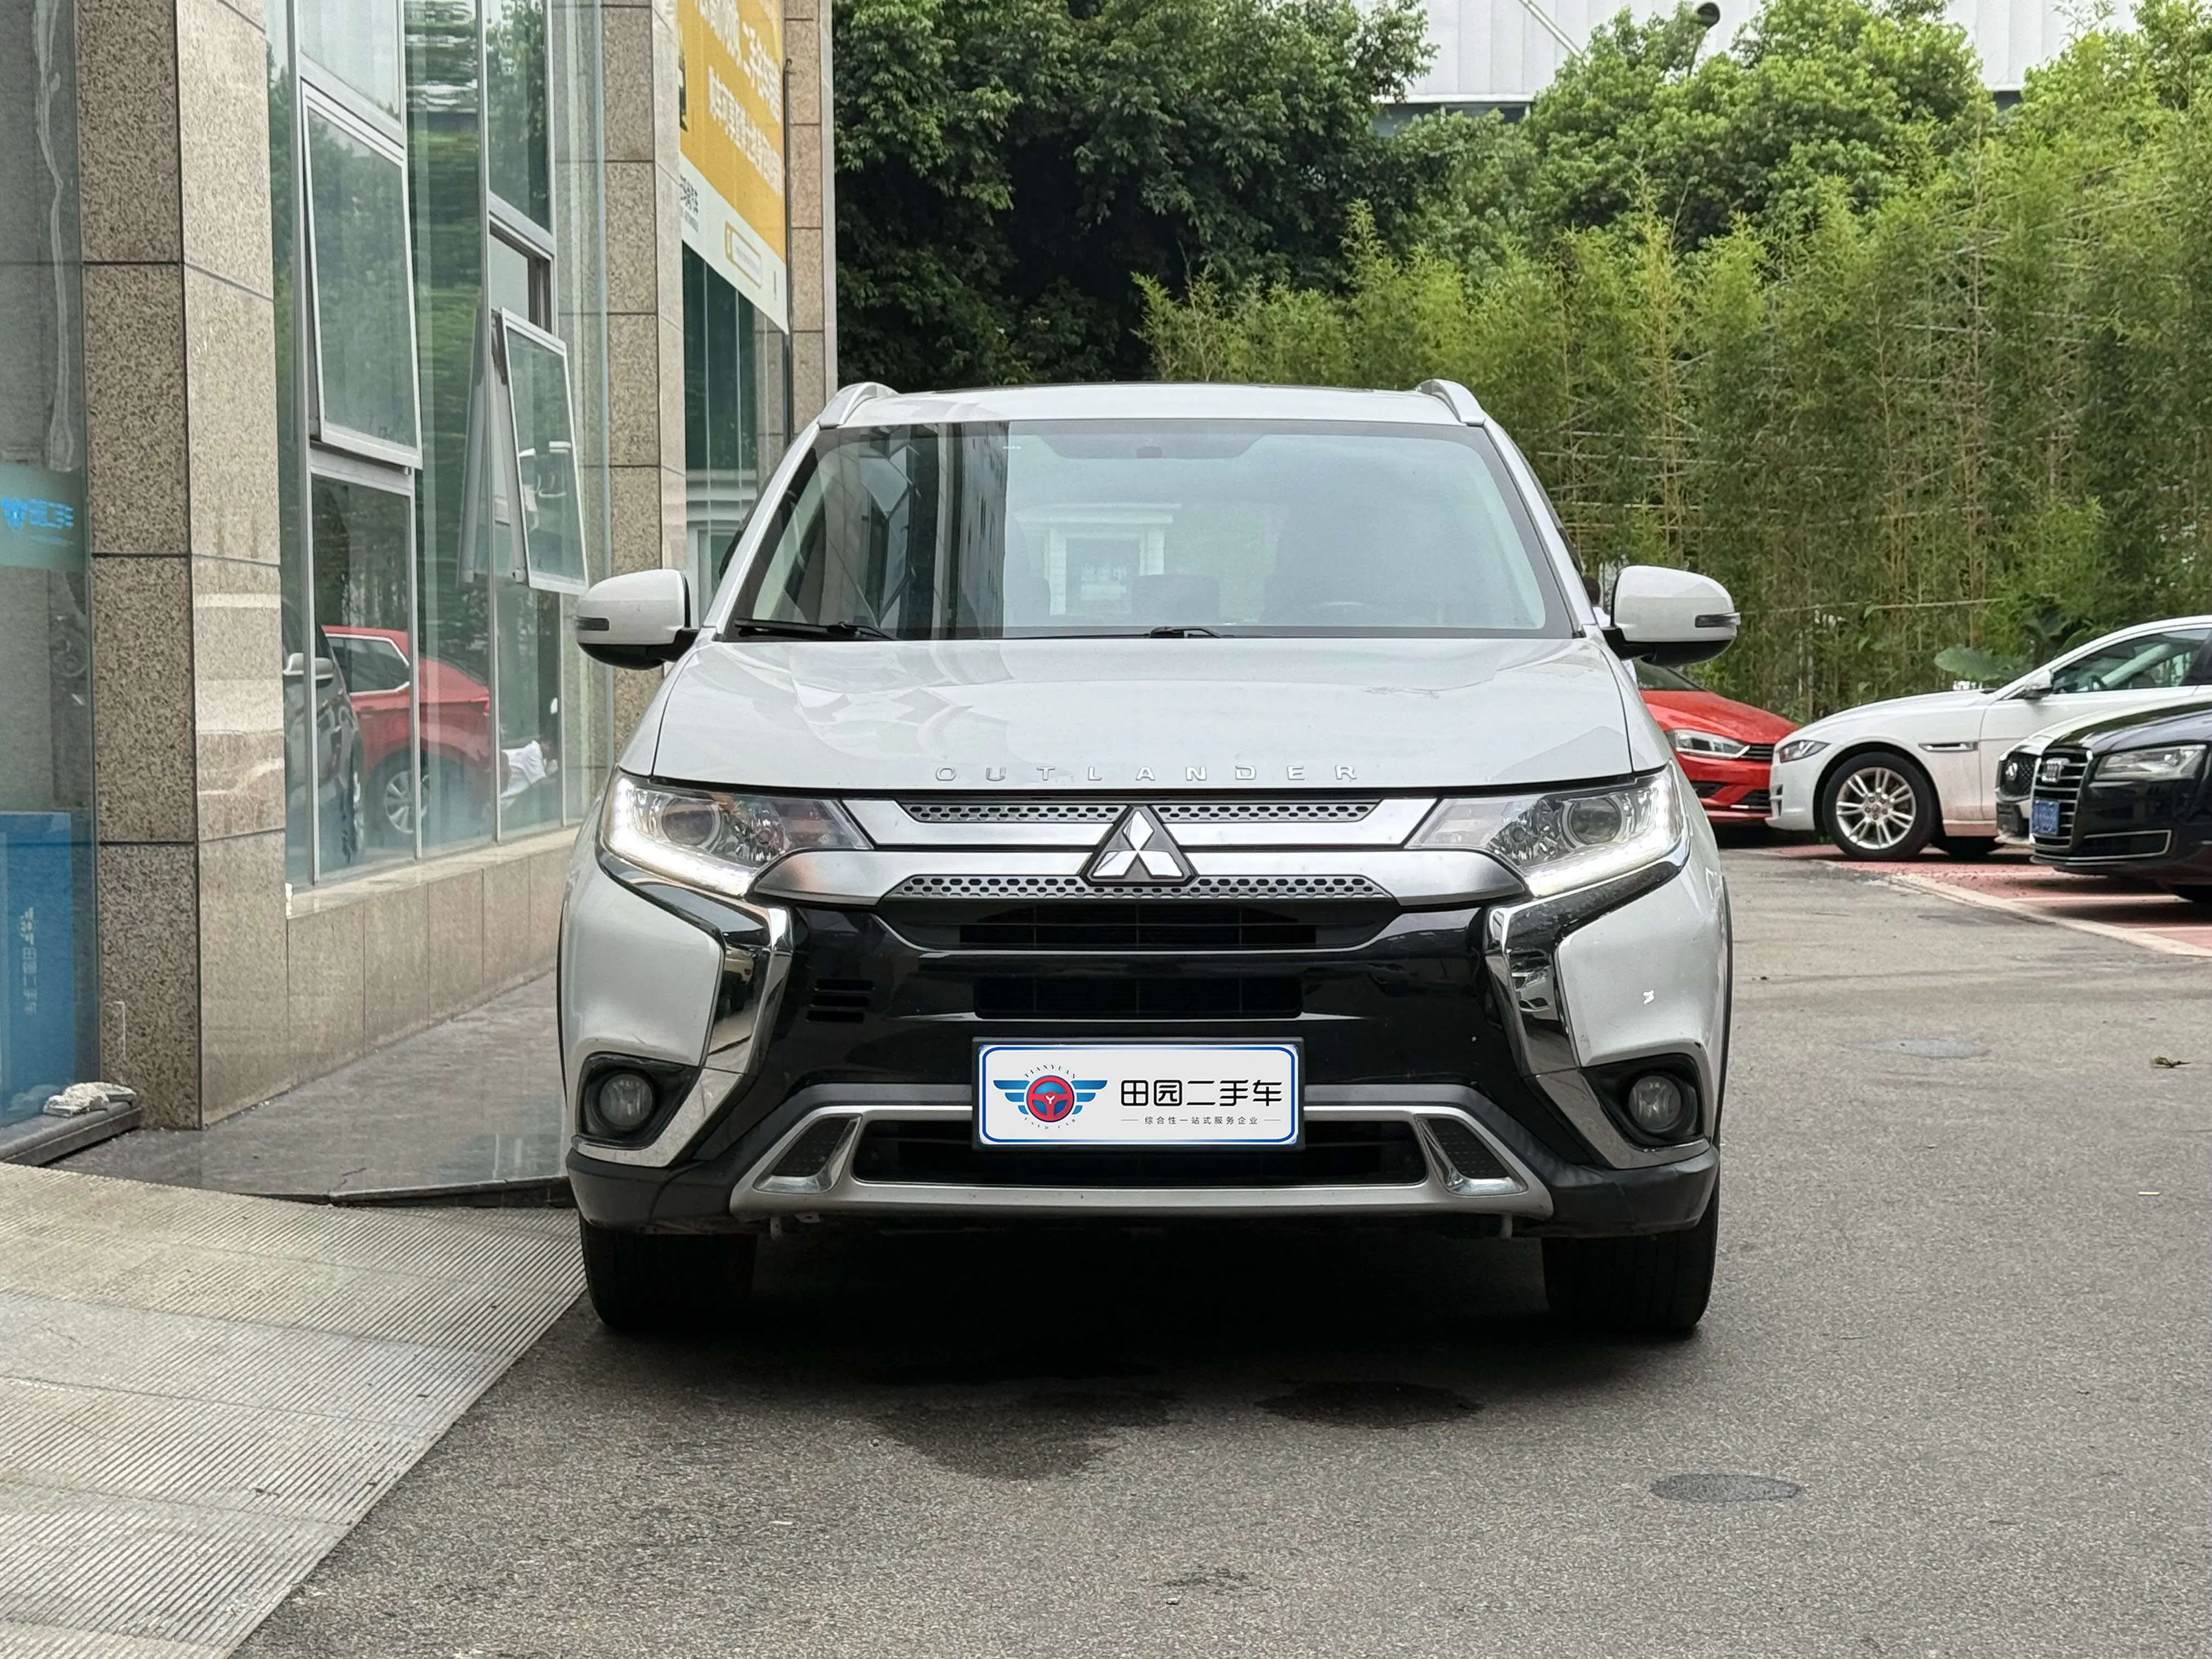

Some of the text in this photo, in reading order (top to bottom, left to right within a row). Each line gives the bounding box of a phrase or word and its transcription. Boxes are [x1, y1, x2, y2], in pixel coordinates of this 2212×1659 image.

[935, 765, 1357, 781] OUTLANDER
[1120, 1079, 1282, 1107] 田园二手车
[1144, 1116, 1259, 1125] 综合性一站式服务企业
